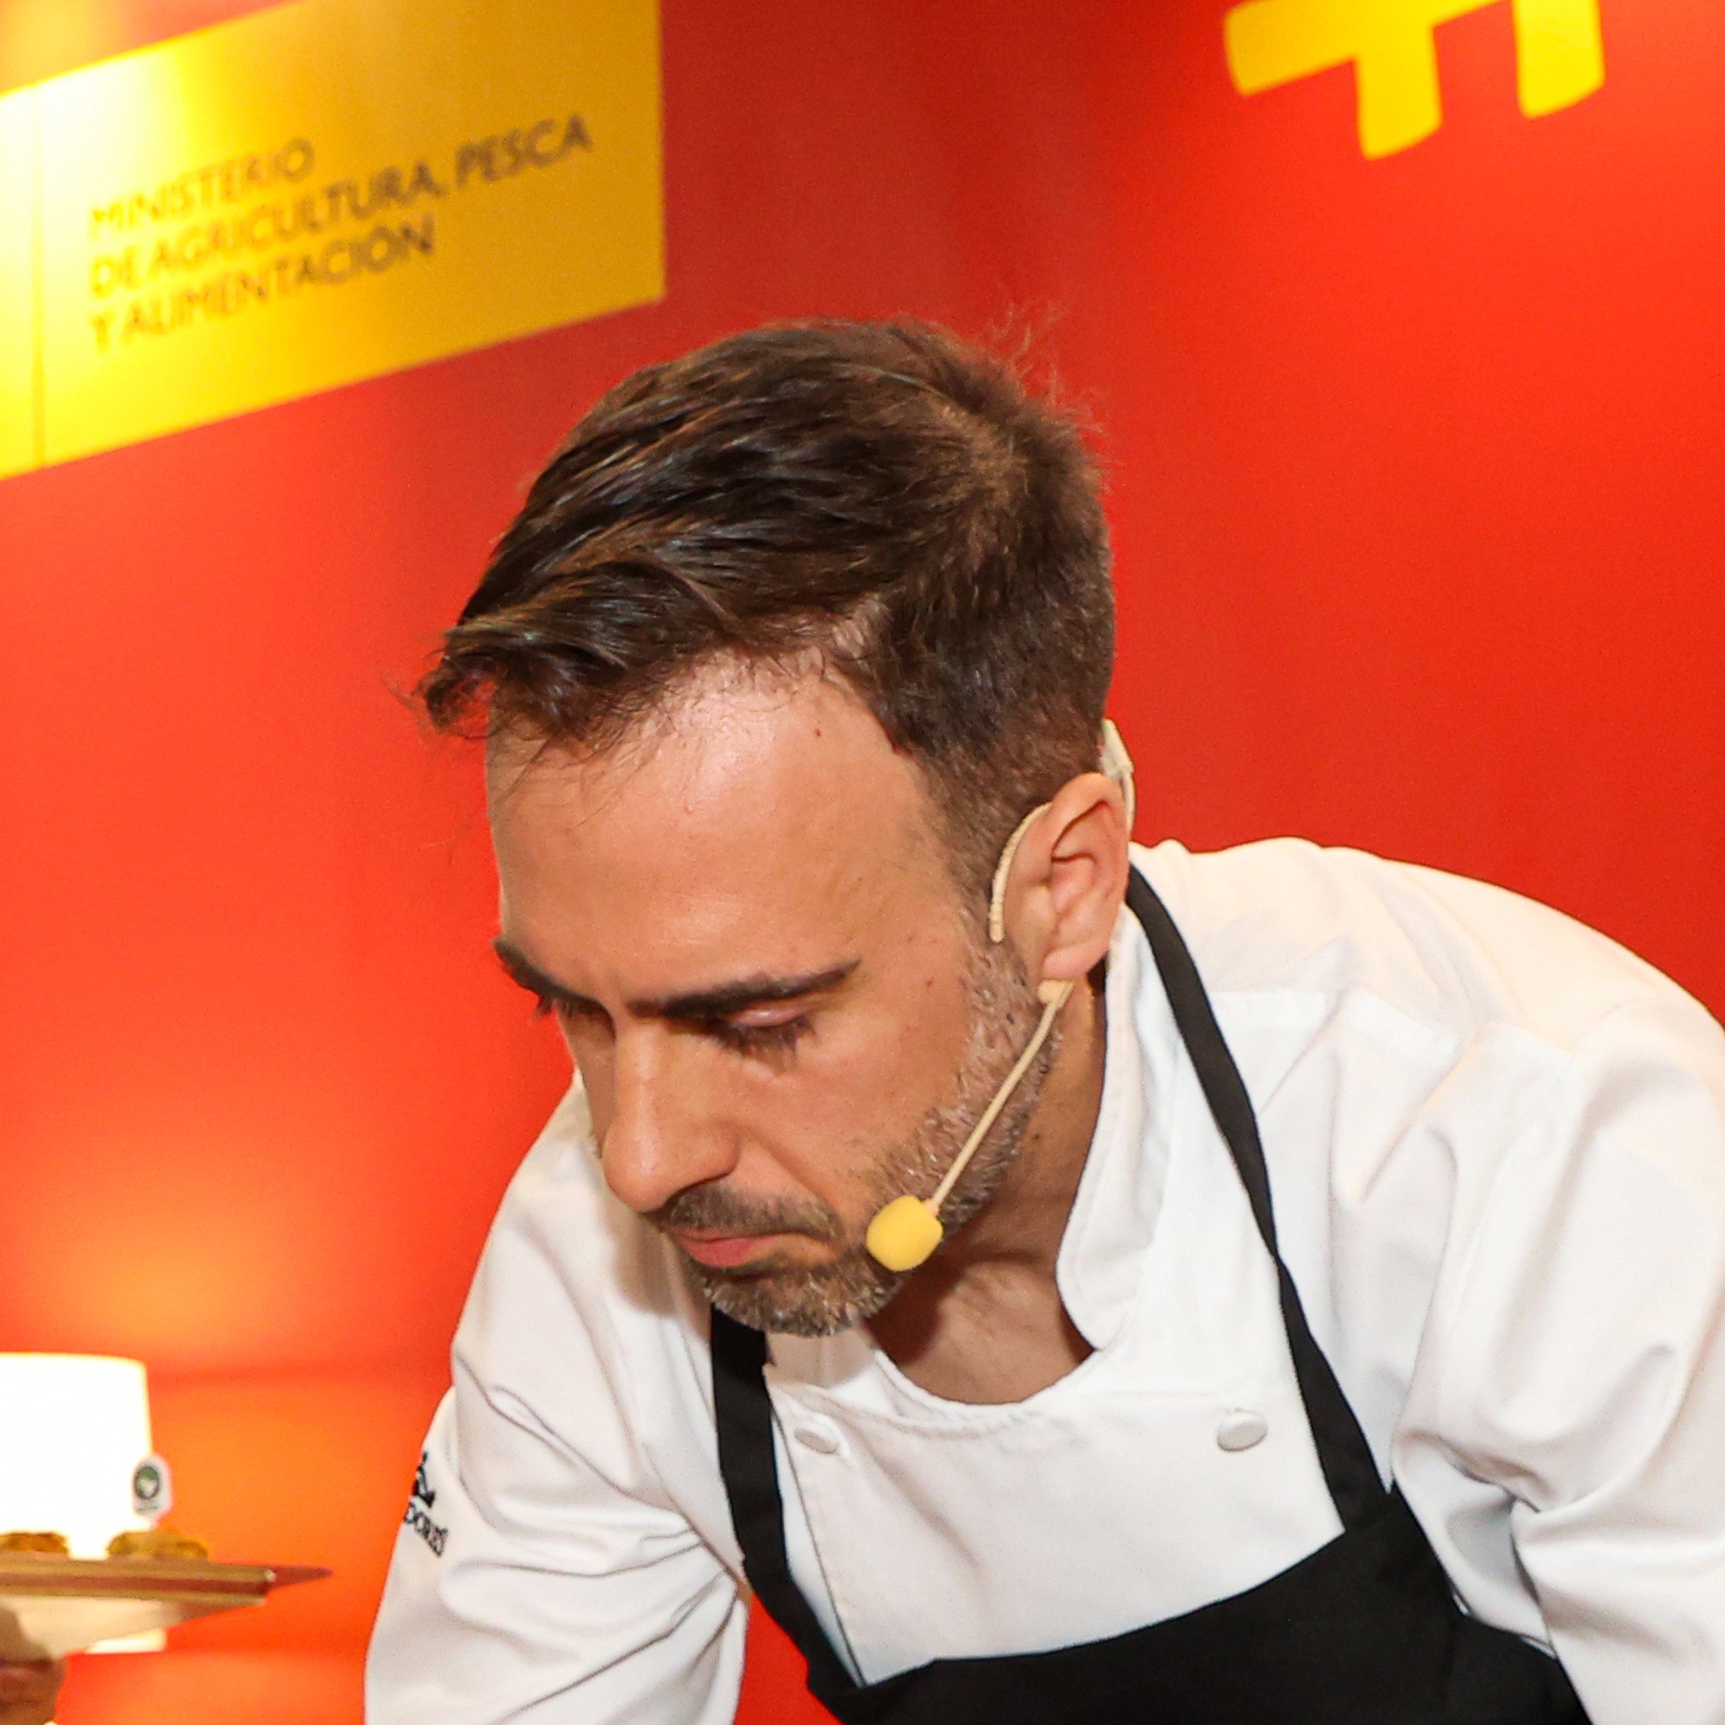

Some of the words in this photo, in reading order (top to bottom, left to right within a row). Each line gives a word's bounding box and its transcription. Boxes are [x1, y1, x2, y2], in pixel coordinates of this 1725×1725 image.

[90, 138, 315, 237] MINISTERIO
[91, 246, 139, 297] DE
[149, 161, 448, 273] AGRICULTURA,
[456, 114, 593, 189] PESCA
[91, 312, 111, 353] Y
